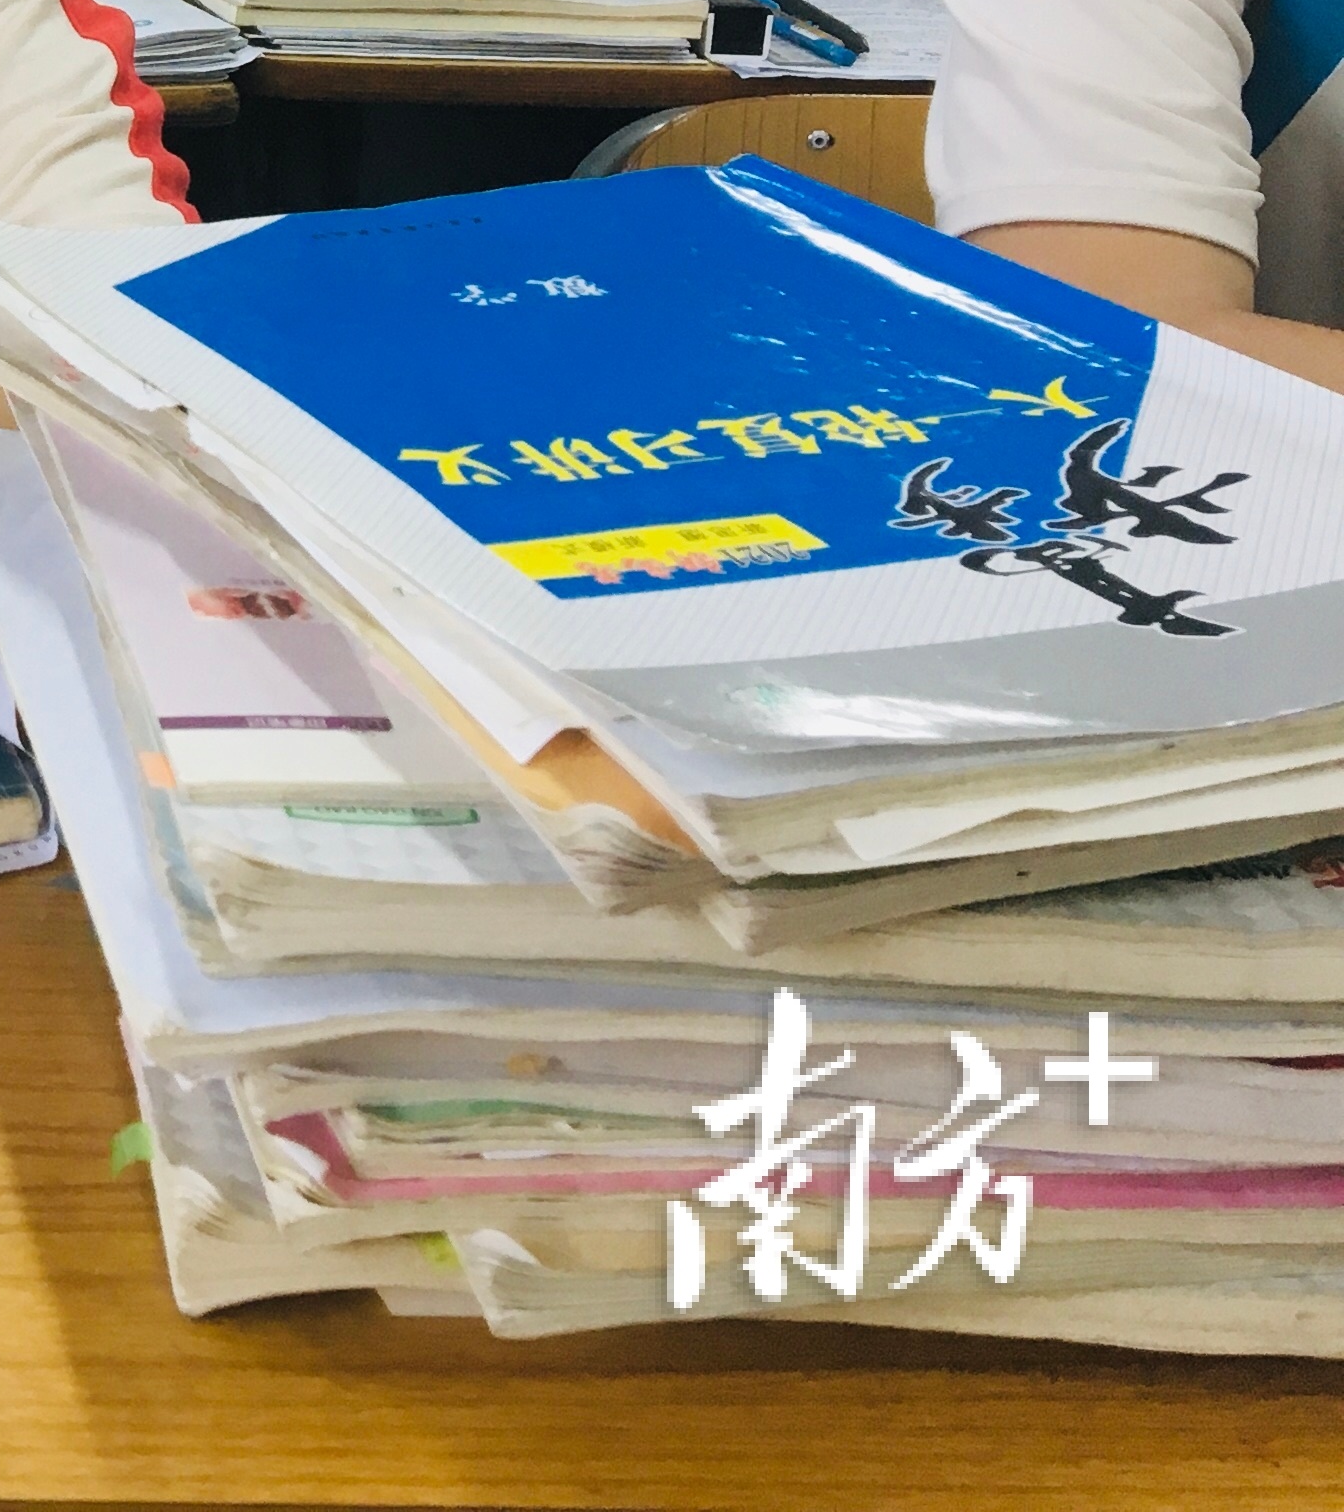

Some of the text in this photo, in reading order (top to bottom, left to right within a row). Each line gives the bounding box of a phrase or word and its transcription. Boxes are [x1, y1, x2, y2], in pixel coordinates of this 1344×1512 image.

[446, 273, 609, 308] 数学
[397, 374, 1110, 488] 大一轮复习讲义
